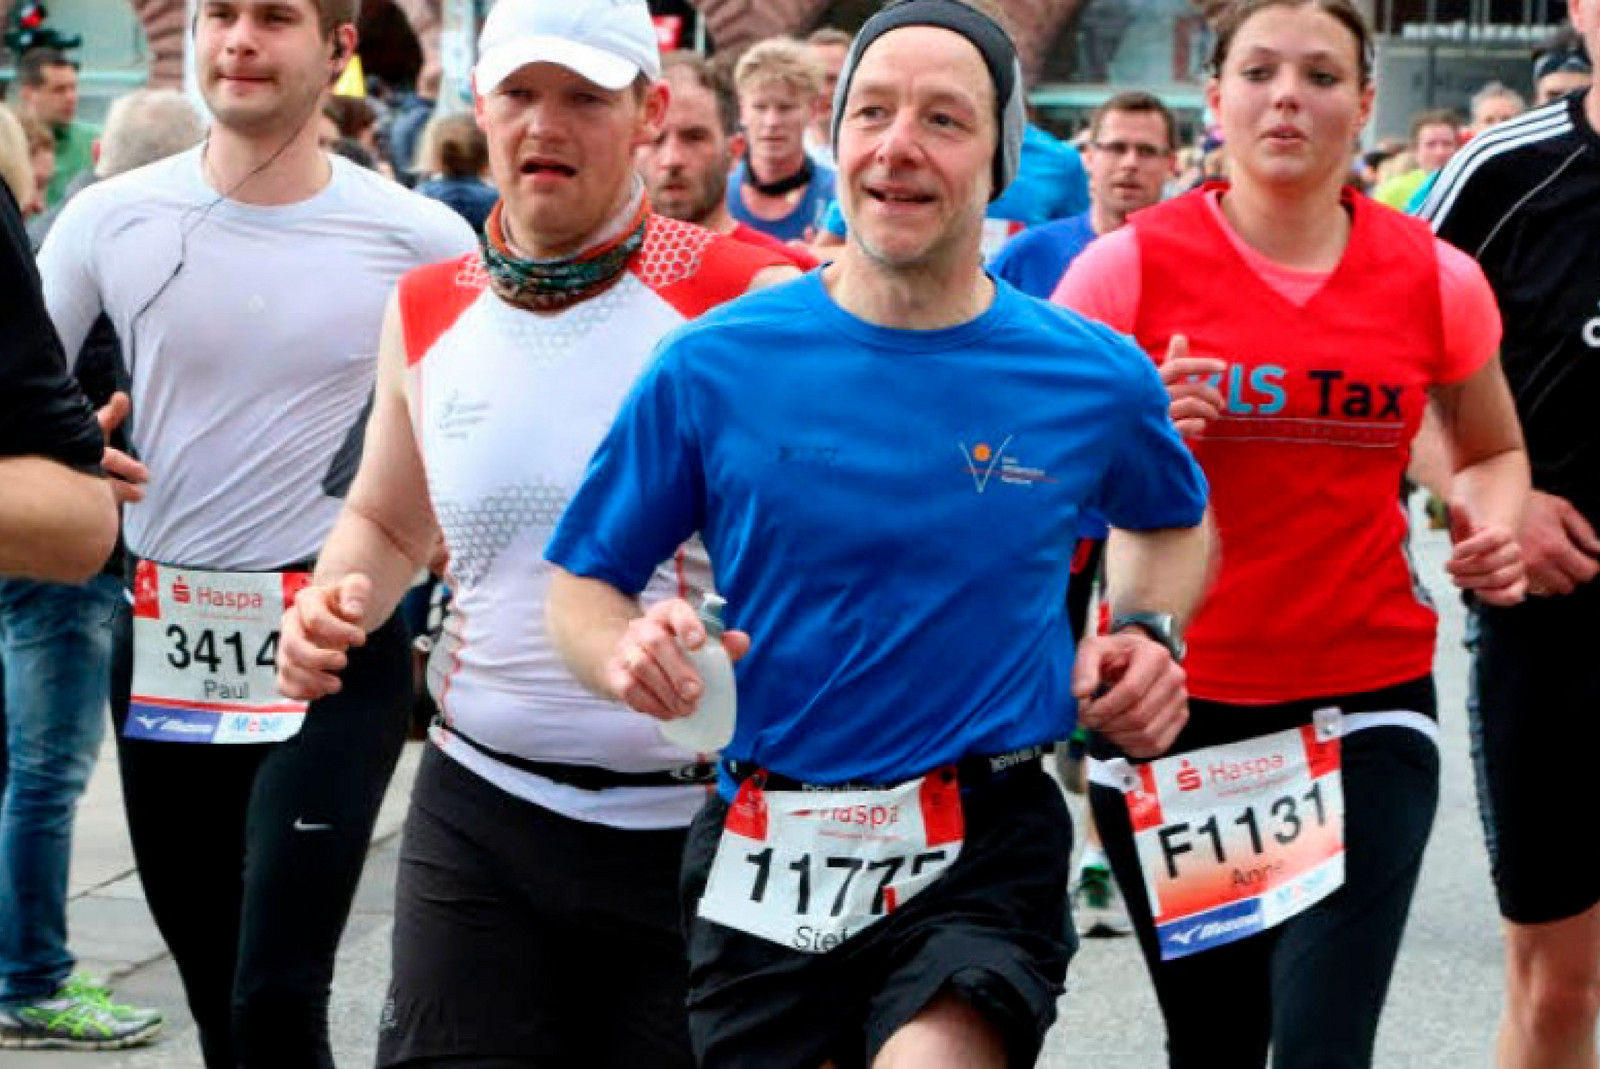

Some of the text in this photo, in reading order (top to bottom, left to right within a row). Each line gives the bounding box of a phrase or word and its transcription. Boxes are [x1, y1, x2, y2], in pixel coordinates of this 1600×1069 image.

[1307, 369, 1404, 418] Tax
[196, 586, 264, 611] Haspa
[203, 679, 249, 700] Paul
[1207, 754, 1286, 784] Haspa
[1157, 782, 1326, 880] F1131
